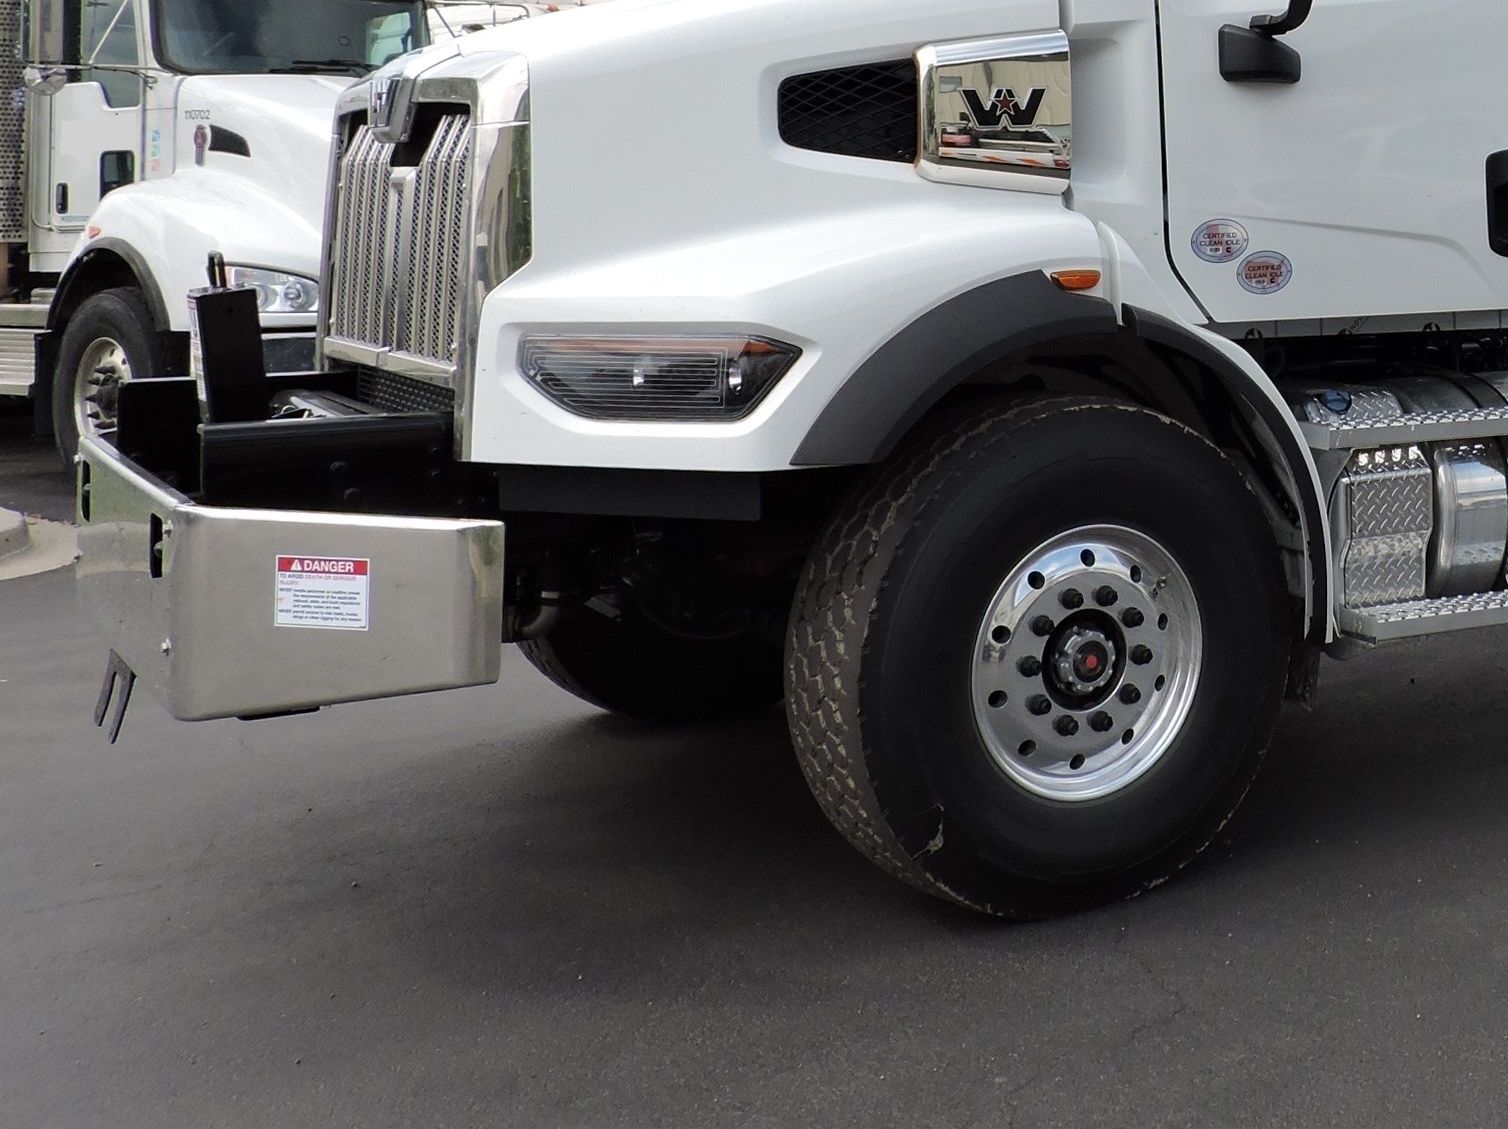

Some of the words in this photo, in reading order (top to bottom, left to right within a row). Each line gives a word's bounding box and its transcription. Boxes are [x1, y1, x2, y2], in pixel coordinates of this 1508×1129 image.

[1203, 232, 1237, 240] CERTIFIED
[1247, 264, 1282, 273] CERTIFIED
[303, 560, 354, 573] DANGER
